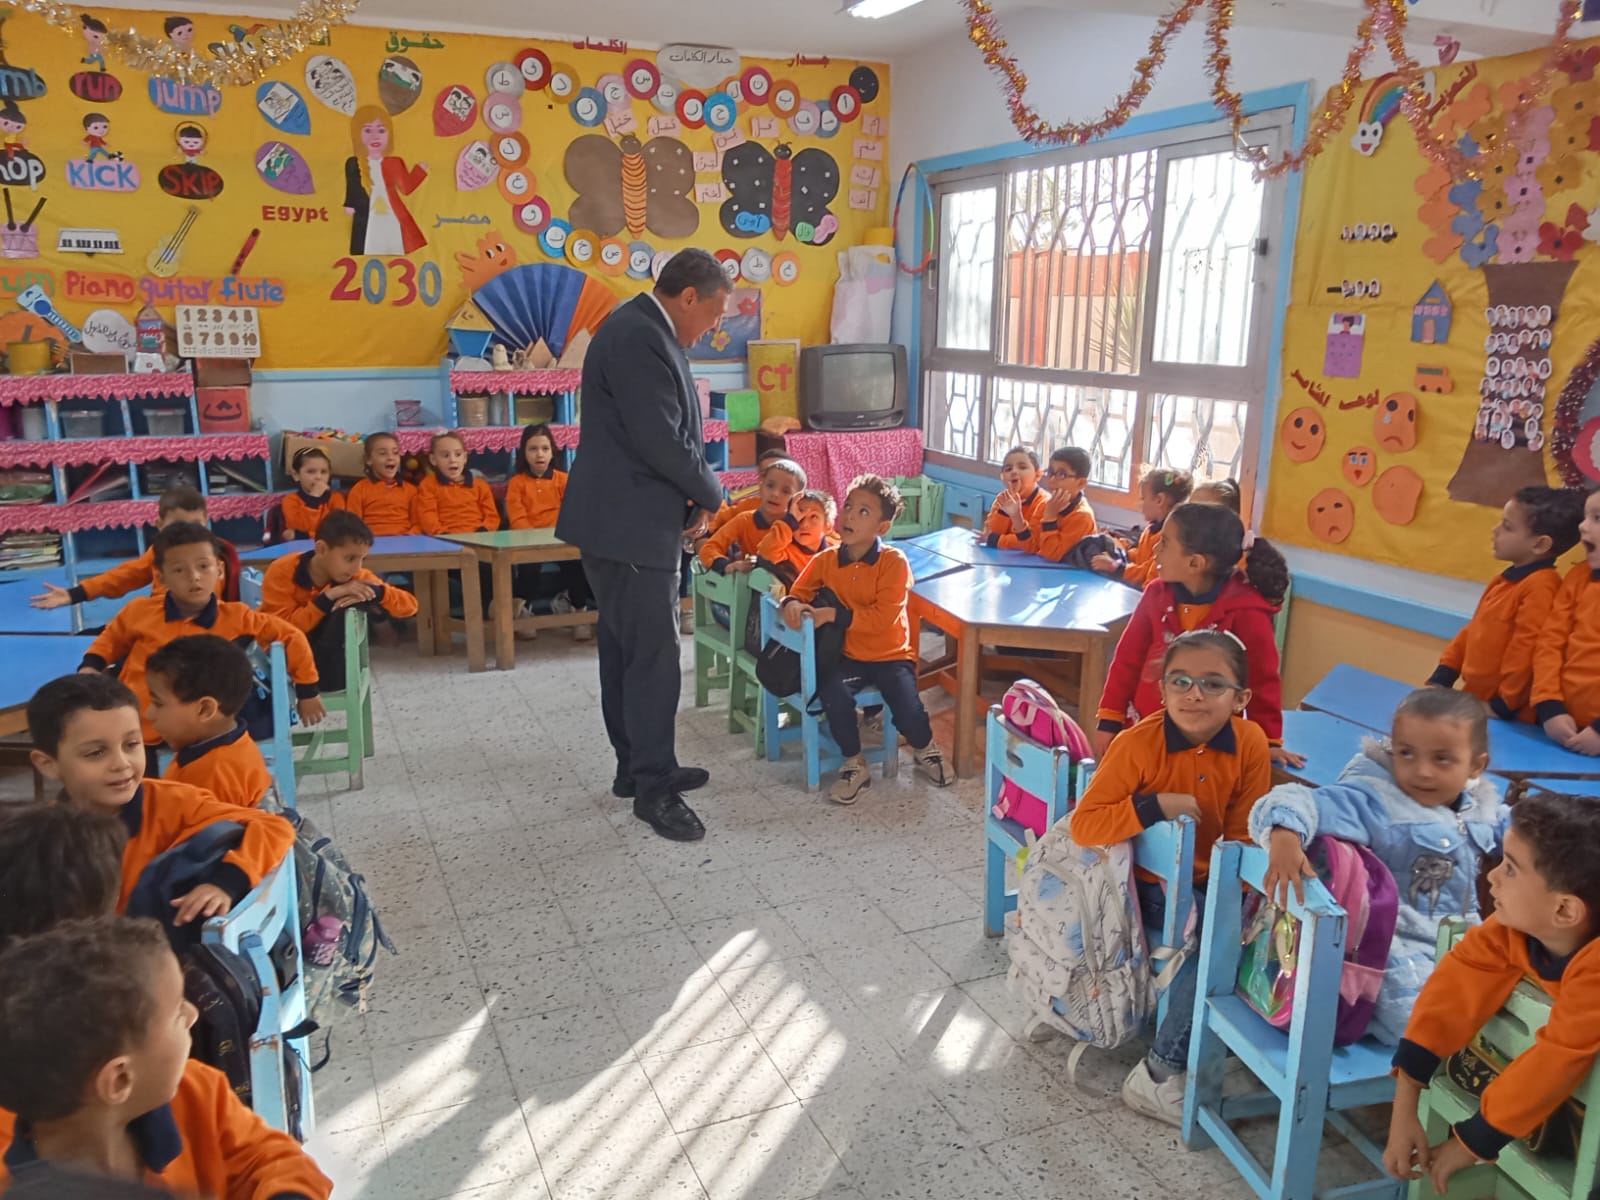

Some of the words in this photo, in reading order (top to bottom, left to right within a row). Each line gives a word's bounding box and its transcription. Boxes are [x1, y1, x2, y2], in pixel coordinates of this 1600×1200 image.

[385, 32, 444, 53] حقوق
[74, 72, 122, 100] run
[262, 205, 328, 223] Egypt
[432, 214, 491, 229] مصر
[65, 271, 135, 299] Piano
[140, 277, 213, 304] guitar
[219, 276, 284, 302] flute
[330, 257, 442, 307] 2030
[183, 308, 191, 322] 1
[197, 308, 208, 322] 2
[212, 309, 223, 323] 3
[228, 309, 239, 323] 4
[198, 332, 209, 346] 7
[242, 332, 257, 346] 10
